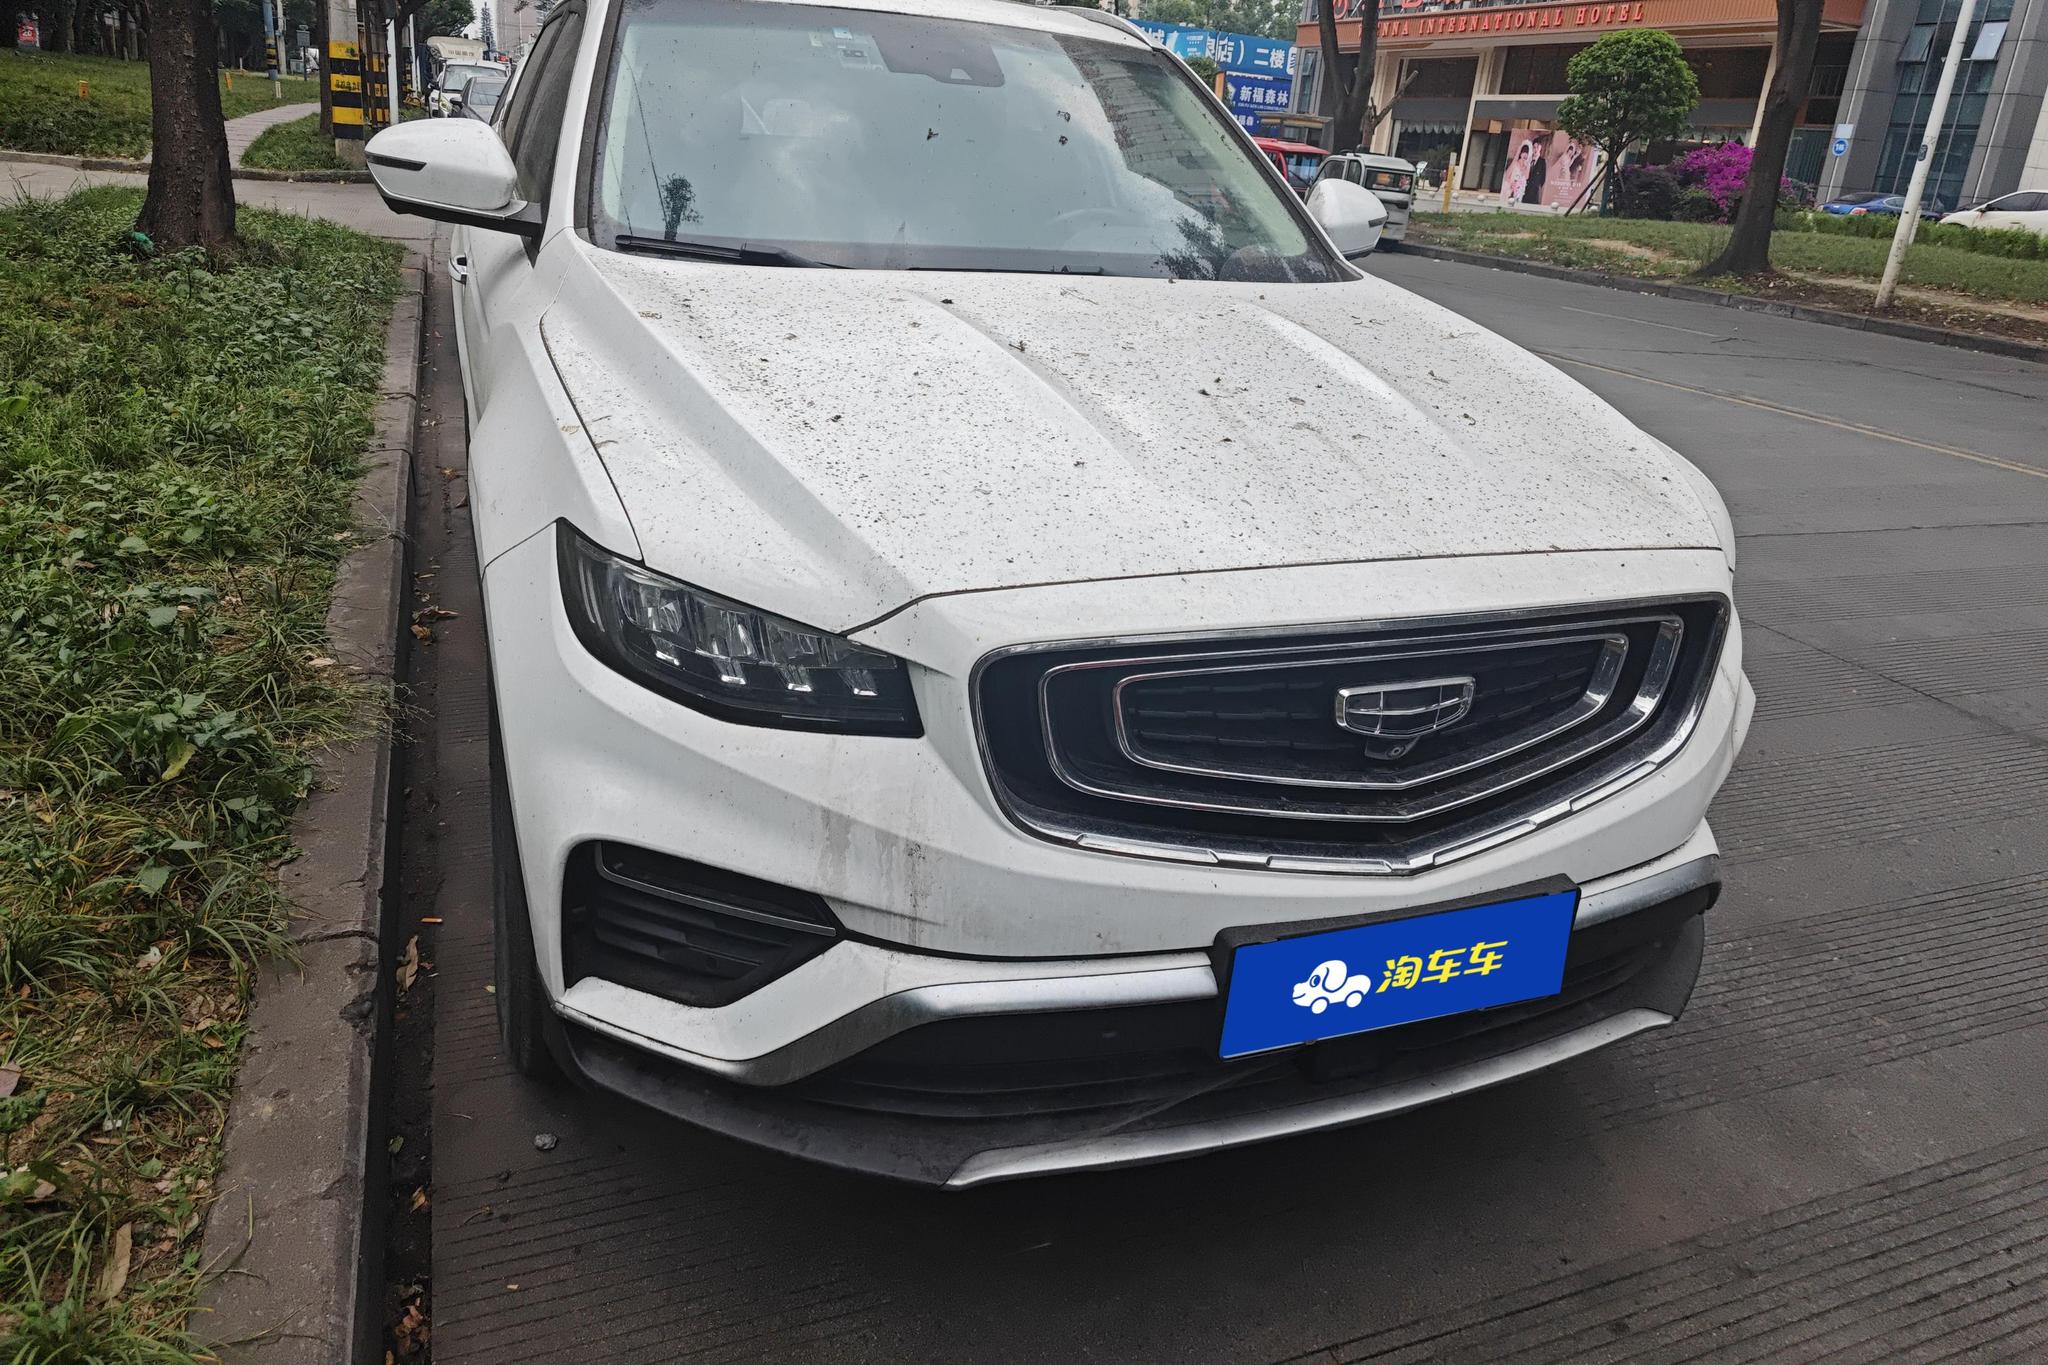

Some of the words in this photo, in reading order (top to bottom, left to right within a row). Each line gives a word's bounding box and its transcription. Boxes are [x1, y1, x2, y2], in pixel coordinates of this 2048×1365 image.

[1419, 9, 1563, 35] INTERNATIONAL
[1576, 3, 1644, 26] HOTEL
[1239, 85, 1289, 106] 新福森林
